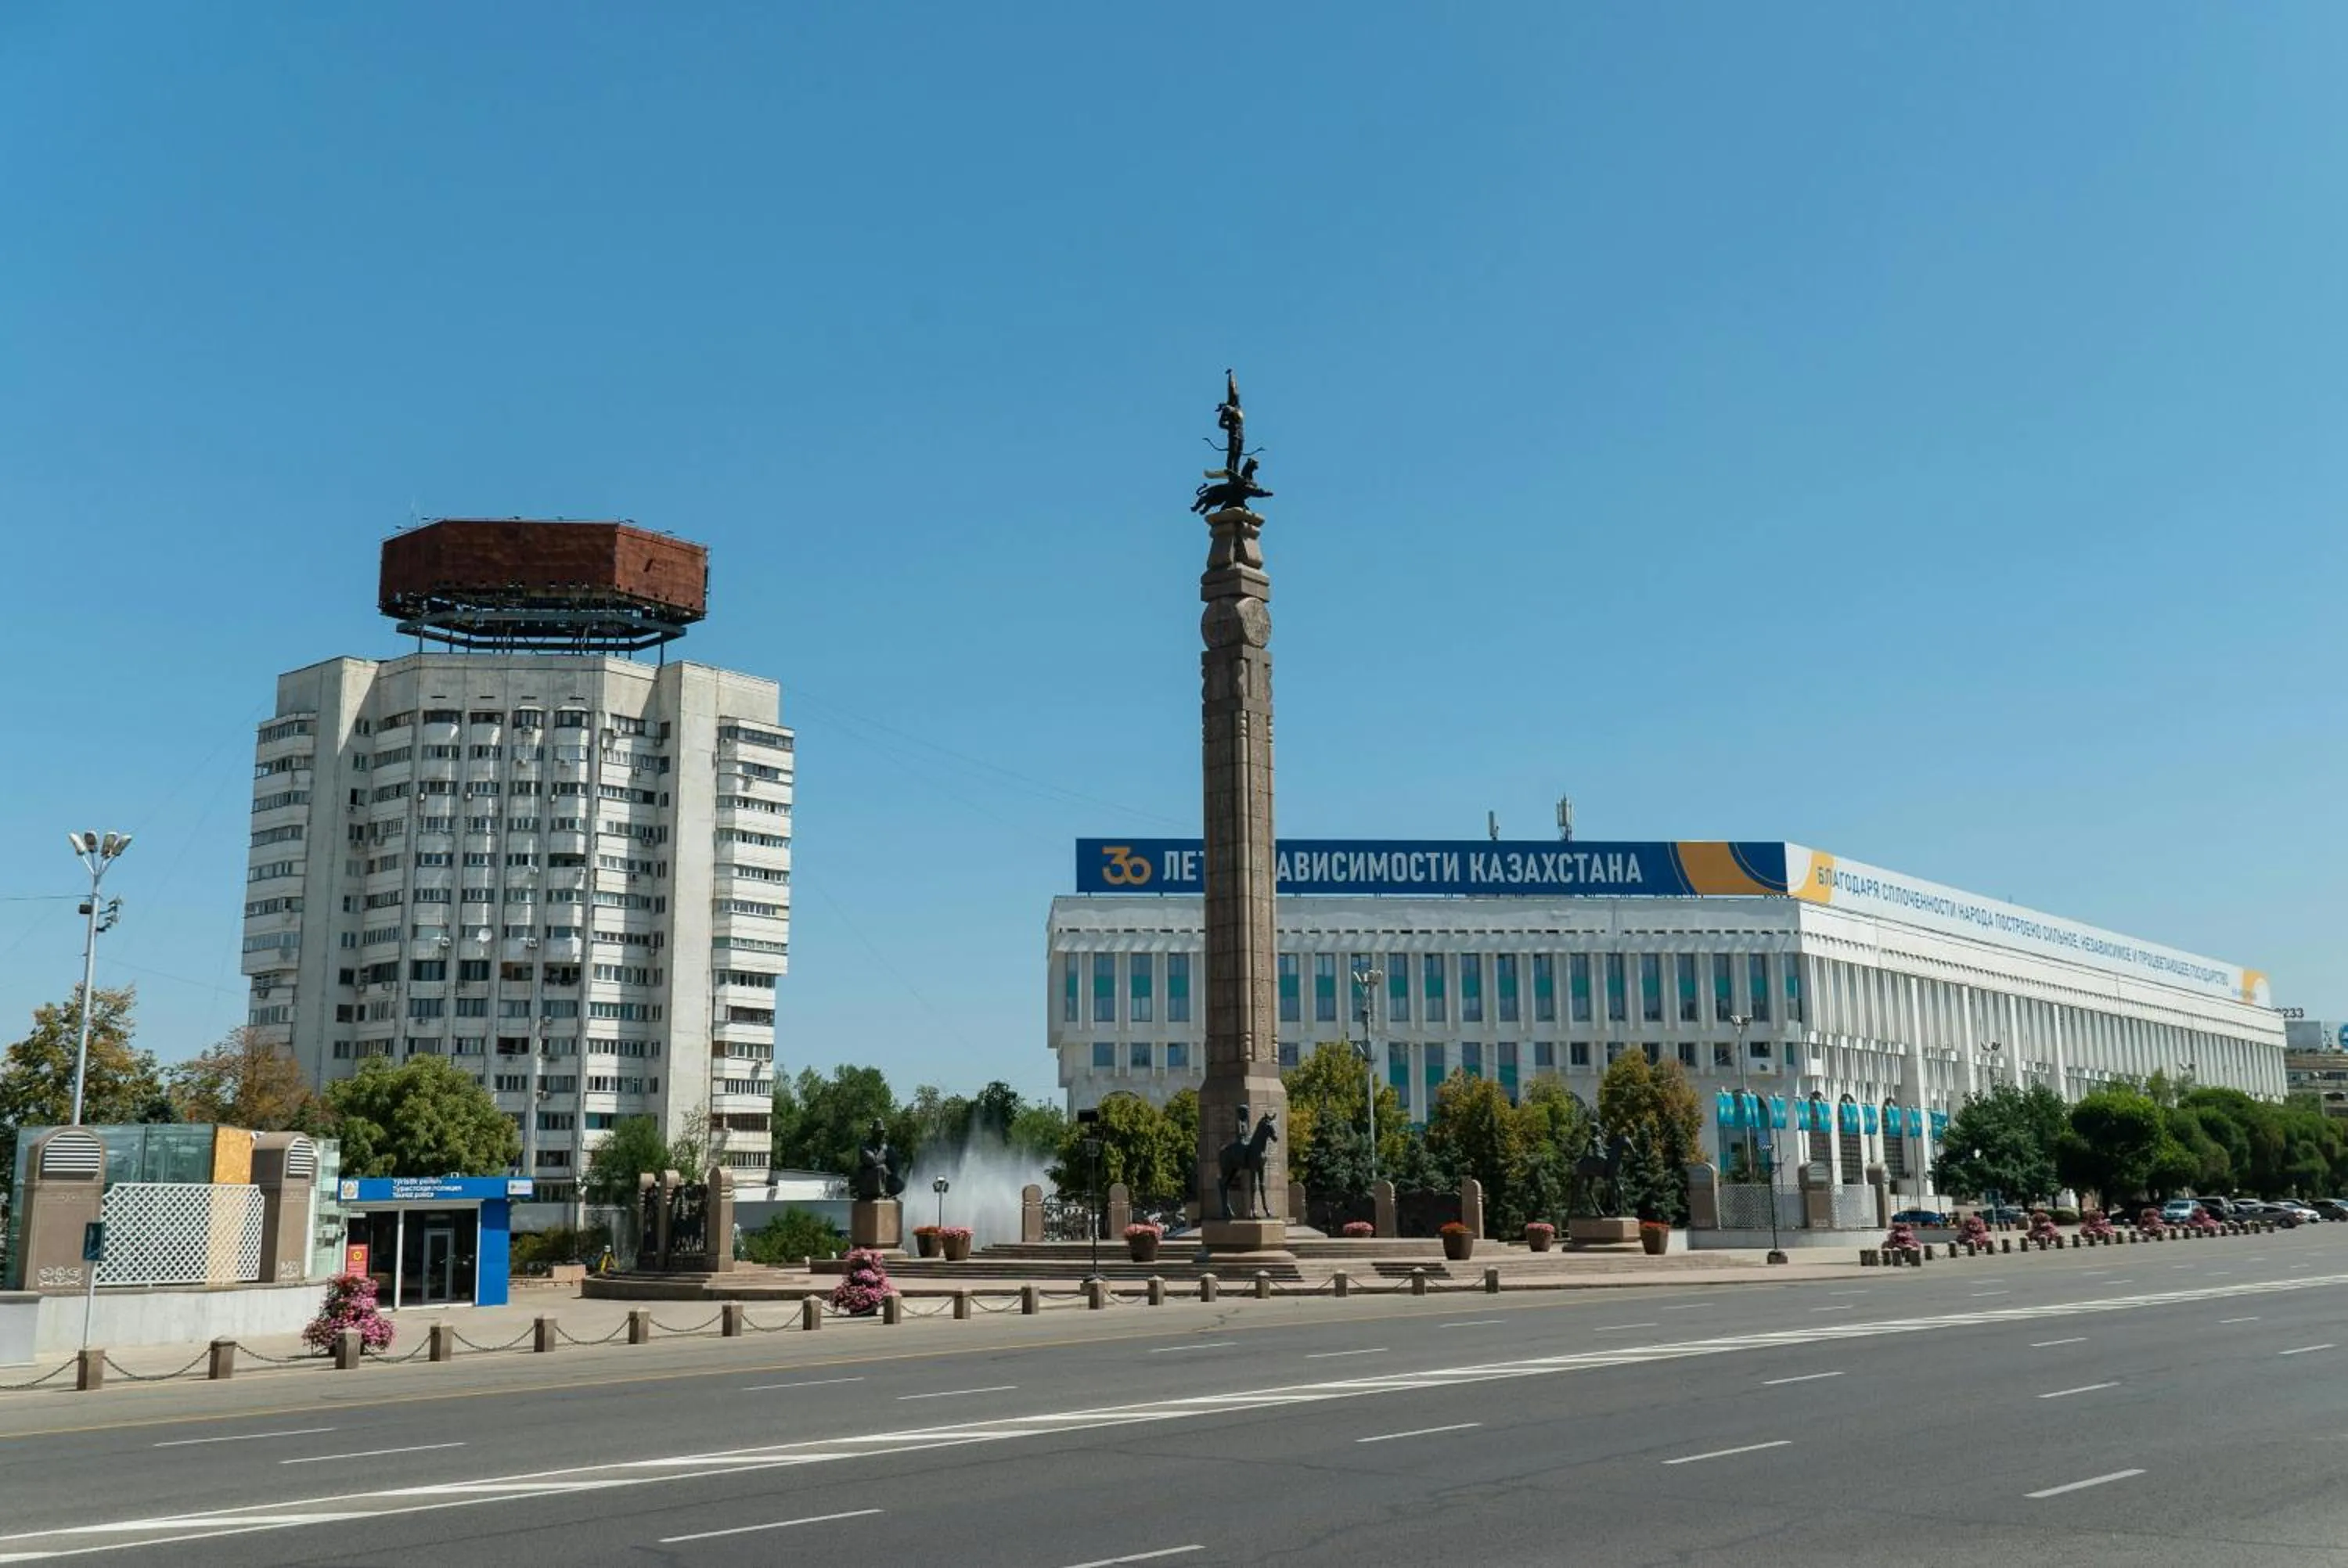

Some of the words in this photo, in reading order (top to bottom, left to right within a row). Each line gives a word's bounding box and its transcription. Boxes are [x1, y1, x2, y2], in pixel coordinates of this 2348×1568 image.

[1102, 846, 1152, 886] 30
[1162, 851, 1205, 882] ЛЕ
[1276, 851, 1460, 883] АВИСИМОСТИ
[1470, 852, 1644, 884] КАЗАХСТАНА
[1817, 866, 1879, 899] БЛАГОДАРЯ
[1882, 883, 1956, 918] СПЛОЧЕННОСТИ
[1958, 904, 1993, 931] НАРОДА
[1995, 912, 2042, 940] ПОСТРОЕНО
